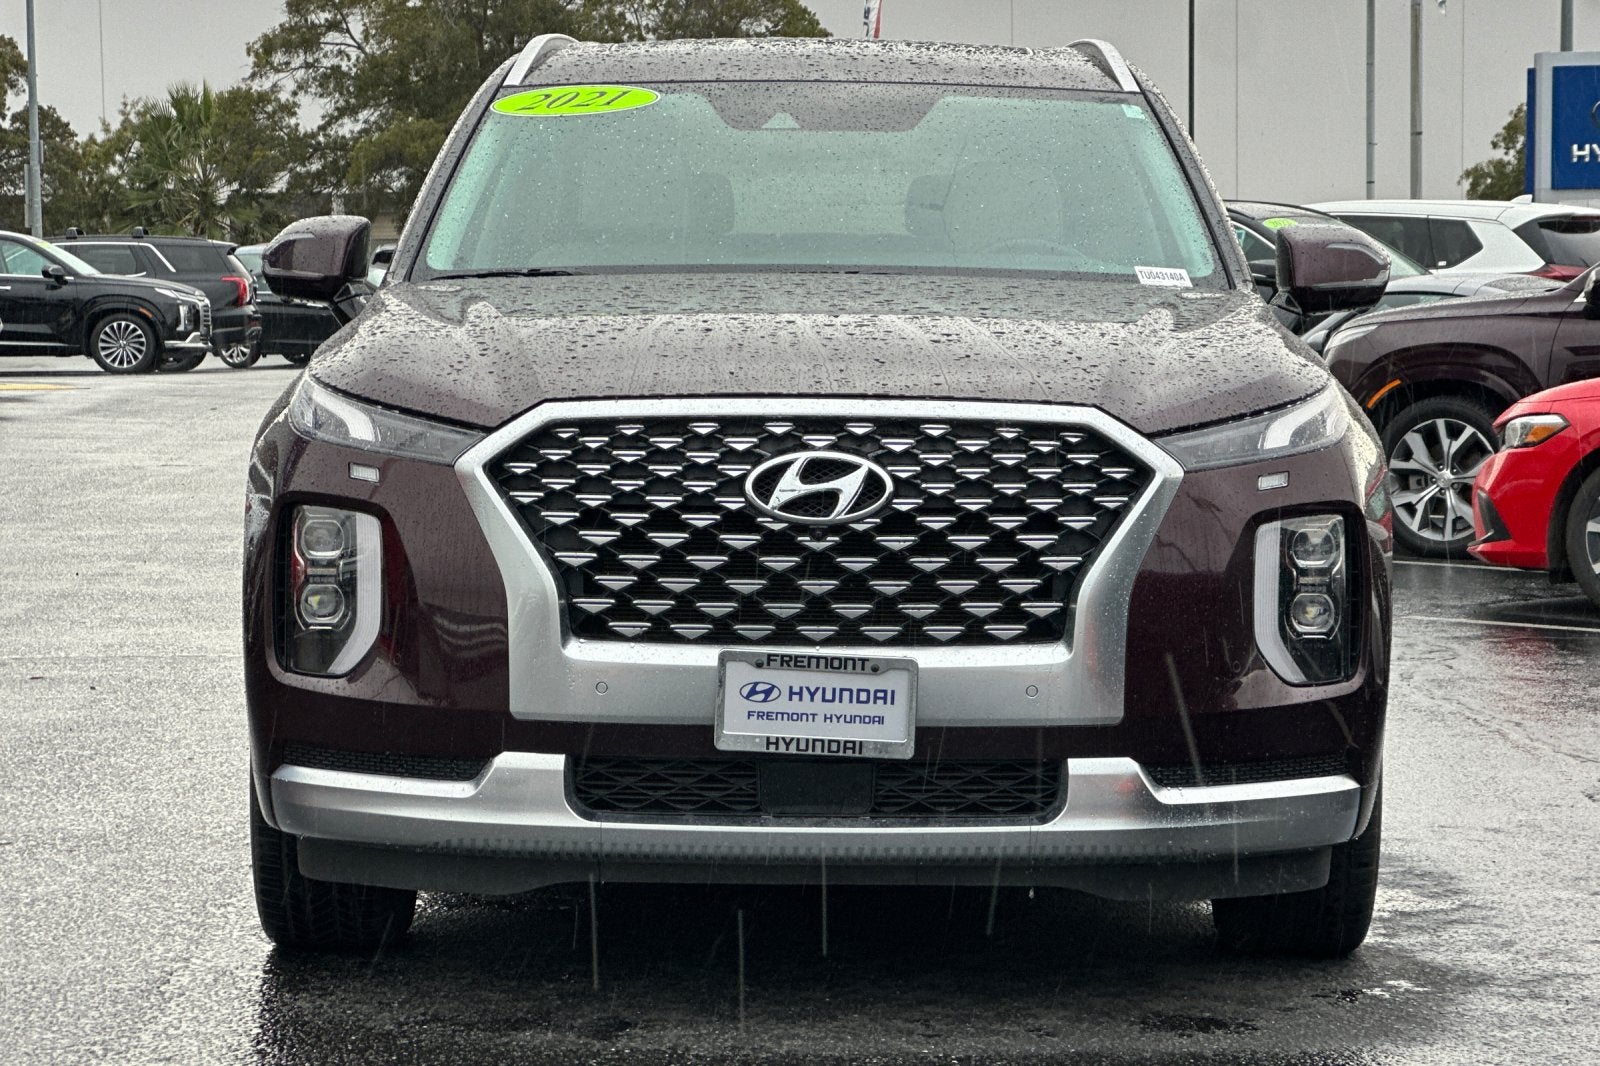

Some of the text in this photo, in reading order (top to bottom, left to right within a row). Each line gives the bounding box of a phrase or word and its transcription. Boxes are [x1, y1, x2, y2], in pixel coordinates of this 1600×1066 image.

[514, 90, 632, 111] 2021
[766, 653, 869, 671] FREMONT
[788, 685, 895, 705] HYUNDAI
[747, 711, 885, 725] FREMONT HYUNDAI
[765, 736, 863, 755] HYUNDAI
